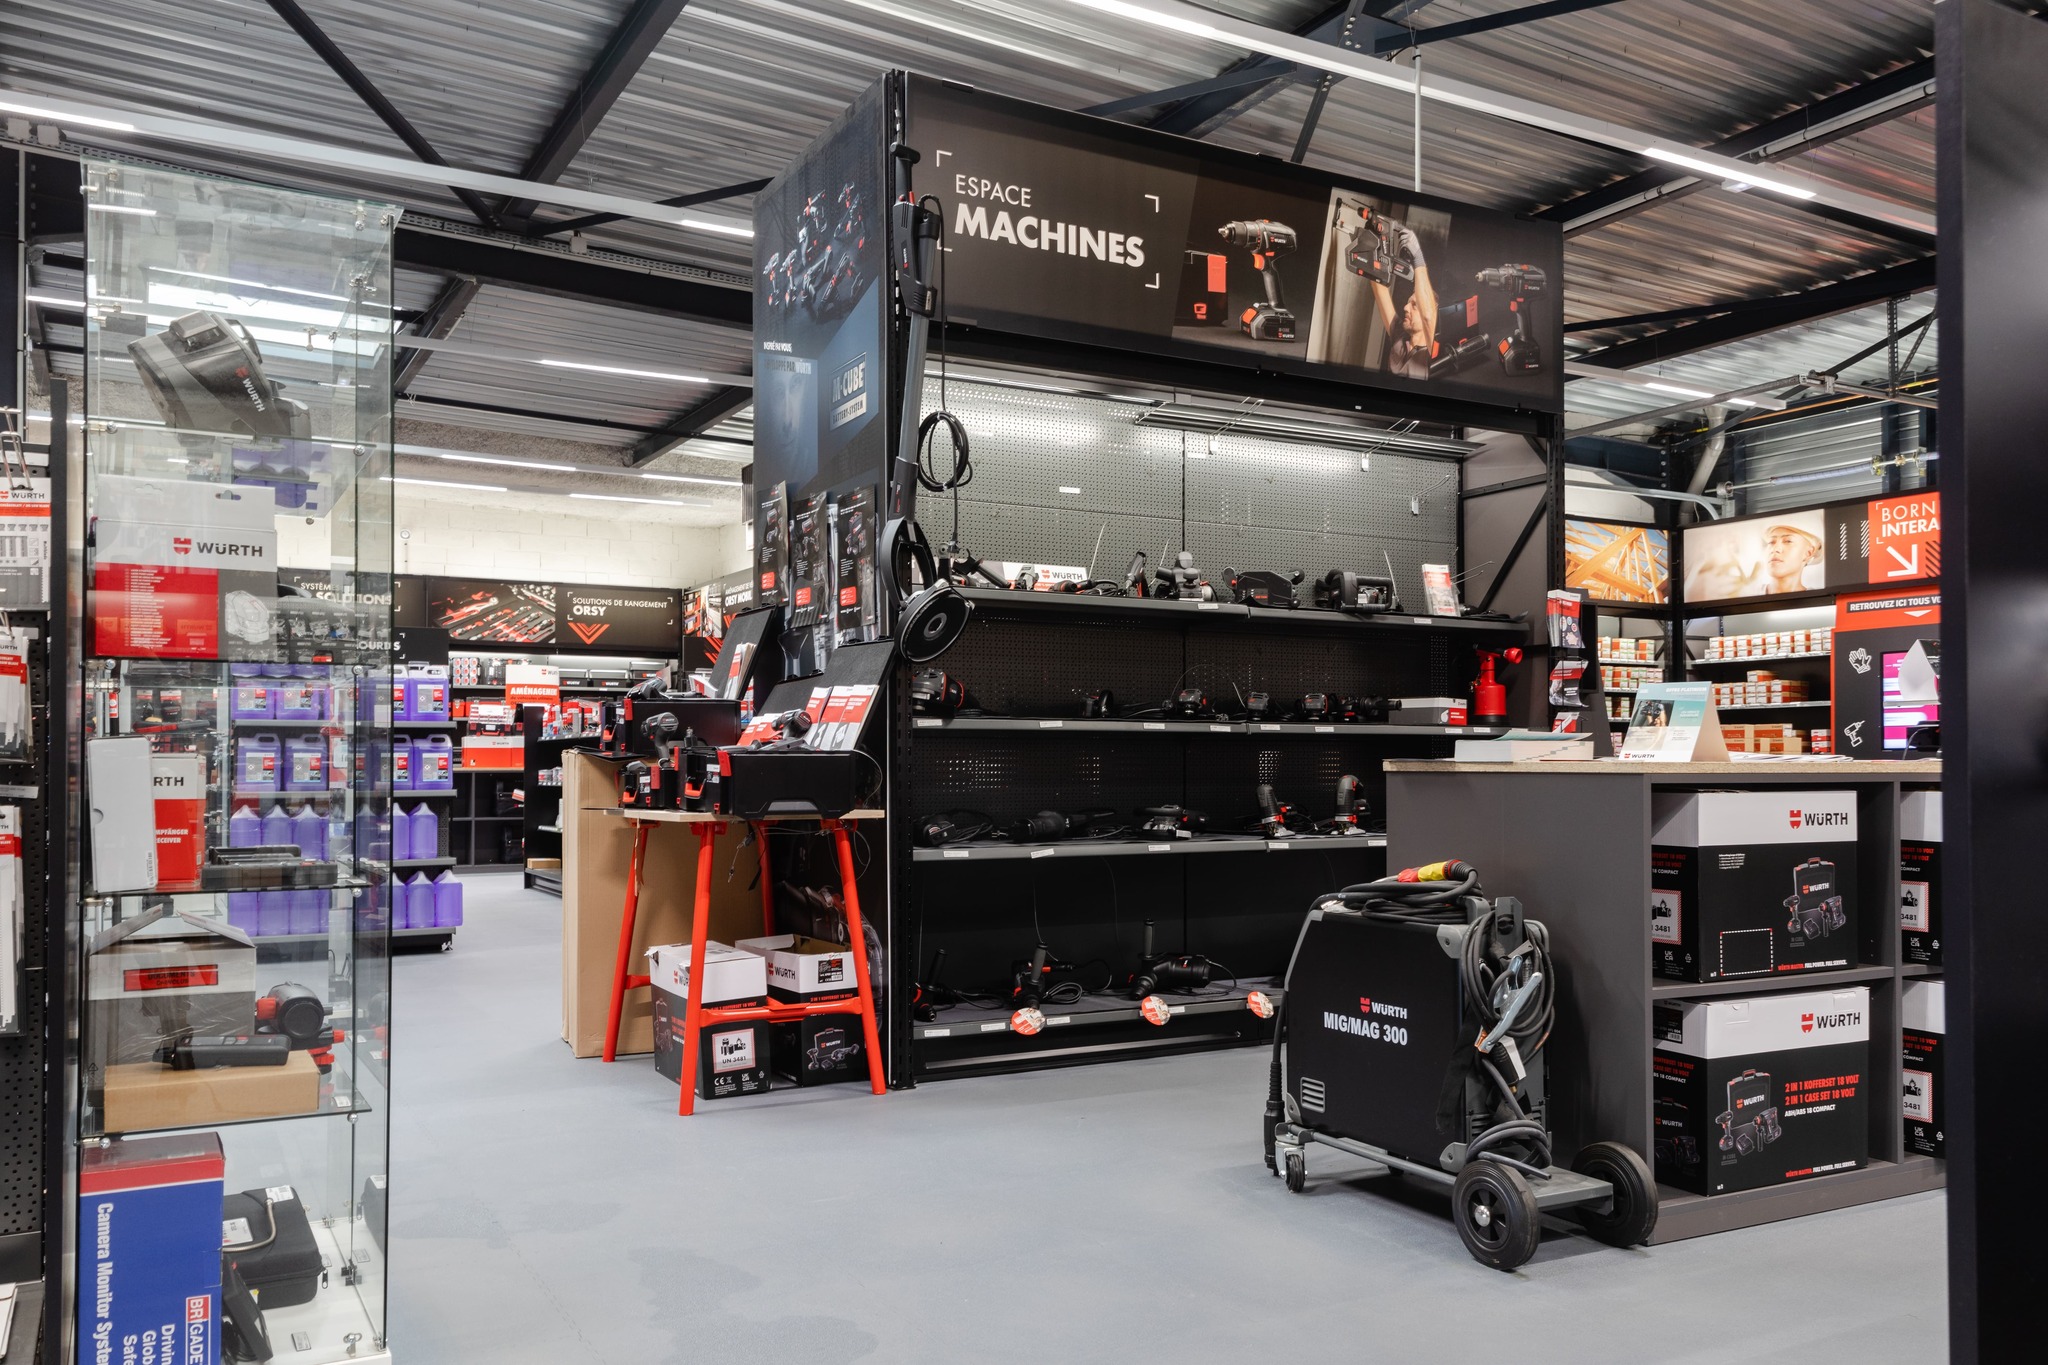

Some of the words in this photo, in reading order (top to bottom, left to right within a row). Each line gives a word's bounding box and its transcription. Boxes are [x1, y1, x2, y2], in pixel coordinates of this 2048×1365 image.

[955, 173, 1032, 208] ESPACE
[954, 202, 1145, 267] MACHINES
[242, 378, 266, 412] WÜRTH
[11, 492, 45, 500] WÜRTH
[1882, 501, 1936, 522] BORN
[1882, 517, 1940, 538] INTERA
[196, 542, 263, 558] WÜRTH
[1052, 572, 1082, 580] WÜRTH
[572, 598, 612, 606] SOLUTIONS
[624, 600, 667, 608] RANGEMENT
[573, 605, 606, 616] ORSY
[1850, 600, 1894, 611] RETROUVEZ
[1896, 599, 1907, 607] ICI
[1908, 598, 1930, 606] TOUS
[1932, 596, 1942, 604] VO
[153, 776, 184, 786] RTH
[1804, 812, 1848, 826] WÜRTH
[1810, 883, 1829, 892] WÜRTH
[775, 966, 796, 980] WÜRTH
[1371, 1002, 1407, 1019] WÜRTH
[1324, 1011, 1380, 1039] MIG/MAG
[1383, 1024, 1408, 1046] 300
[1816, 1012, 1860, 1029] WÜRTH
[1666, 1075, 1686, 1084] COMPACT
[1785, 1083, 1790, 1092] 2
[1790, 1082, 1798, 1092] IN
[1800, 1081, 1803, 1090] 1
[1804, 1077, 1836, 1090] KOFFERSET
[1837, 1076, 1844, 1085] 18
[1845, 1074, 1859, 1084] VOLT
[1744, 1094, 1764, 1106] WÜRTH
[1785, 1096, 1790, 1106] 2
[1790, 1095, 1798, 1104] IN
[1800, 1094, 1803, 1103] 1
[1804, 1092, 1819, 1103] CASE
[1820, 1091, 1831, 1100] SET
[1832, 1090, 1840, 1099] 18
[1841, 1088, 1855, 1098] VOLT
[1813, 1104, 1836, 1113] COMPACT
[1903, 1102, 1920, 1110] 3481
[1662, 1120, 1683, 1128] WÜRTH
[97, 1203, 114, 1259] Camera
[97, 1262, 113, 1318] Monitor
[190, 1298, 204, 1364] BRIGADE
[123, 1334, 137, 1365] Safe
[142, 1330, 156, 1365] Glob
[161, 1324, 175, 1365] Drivin
